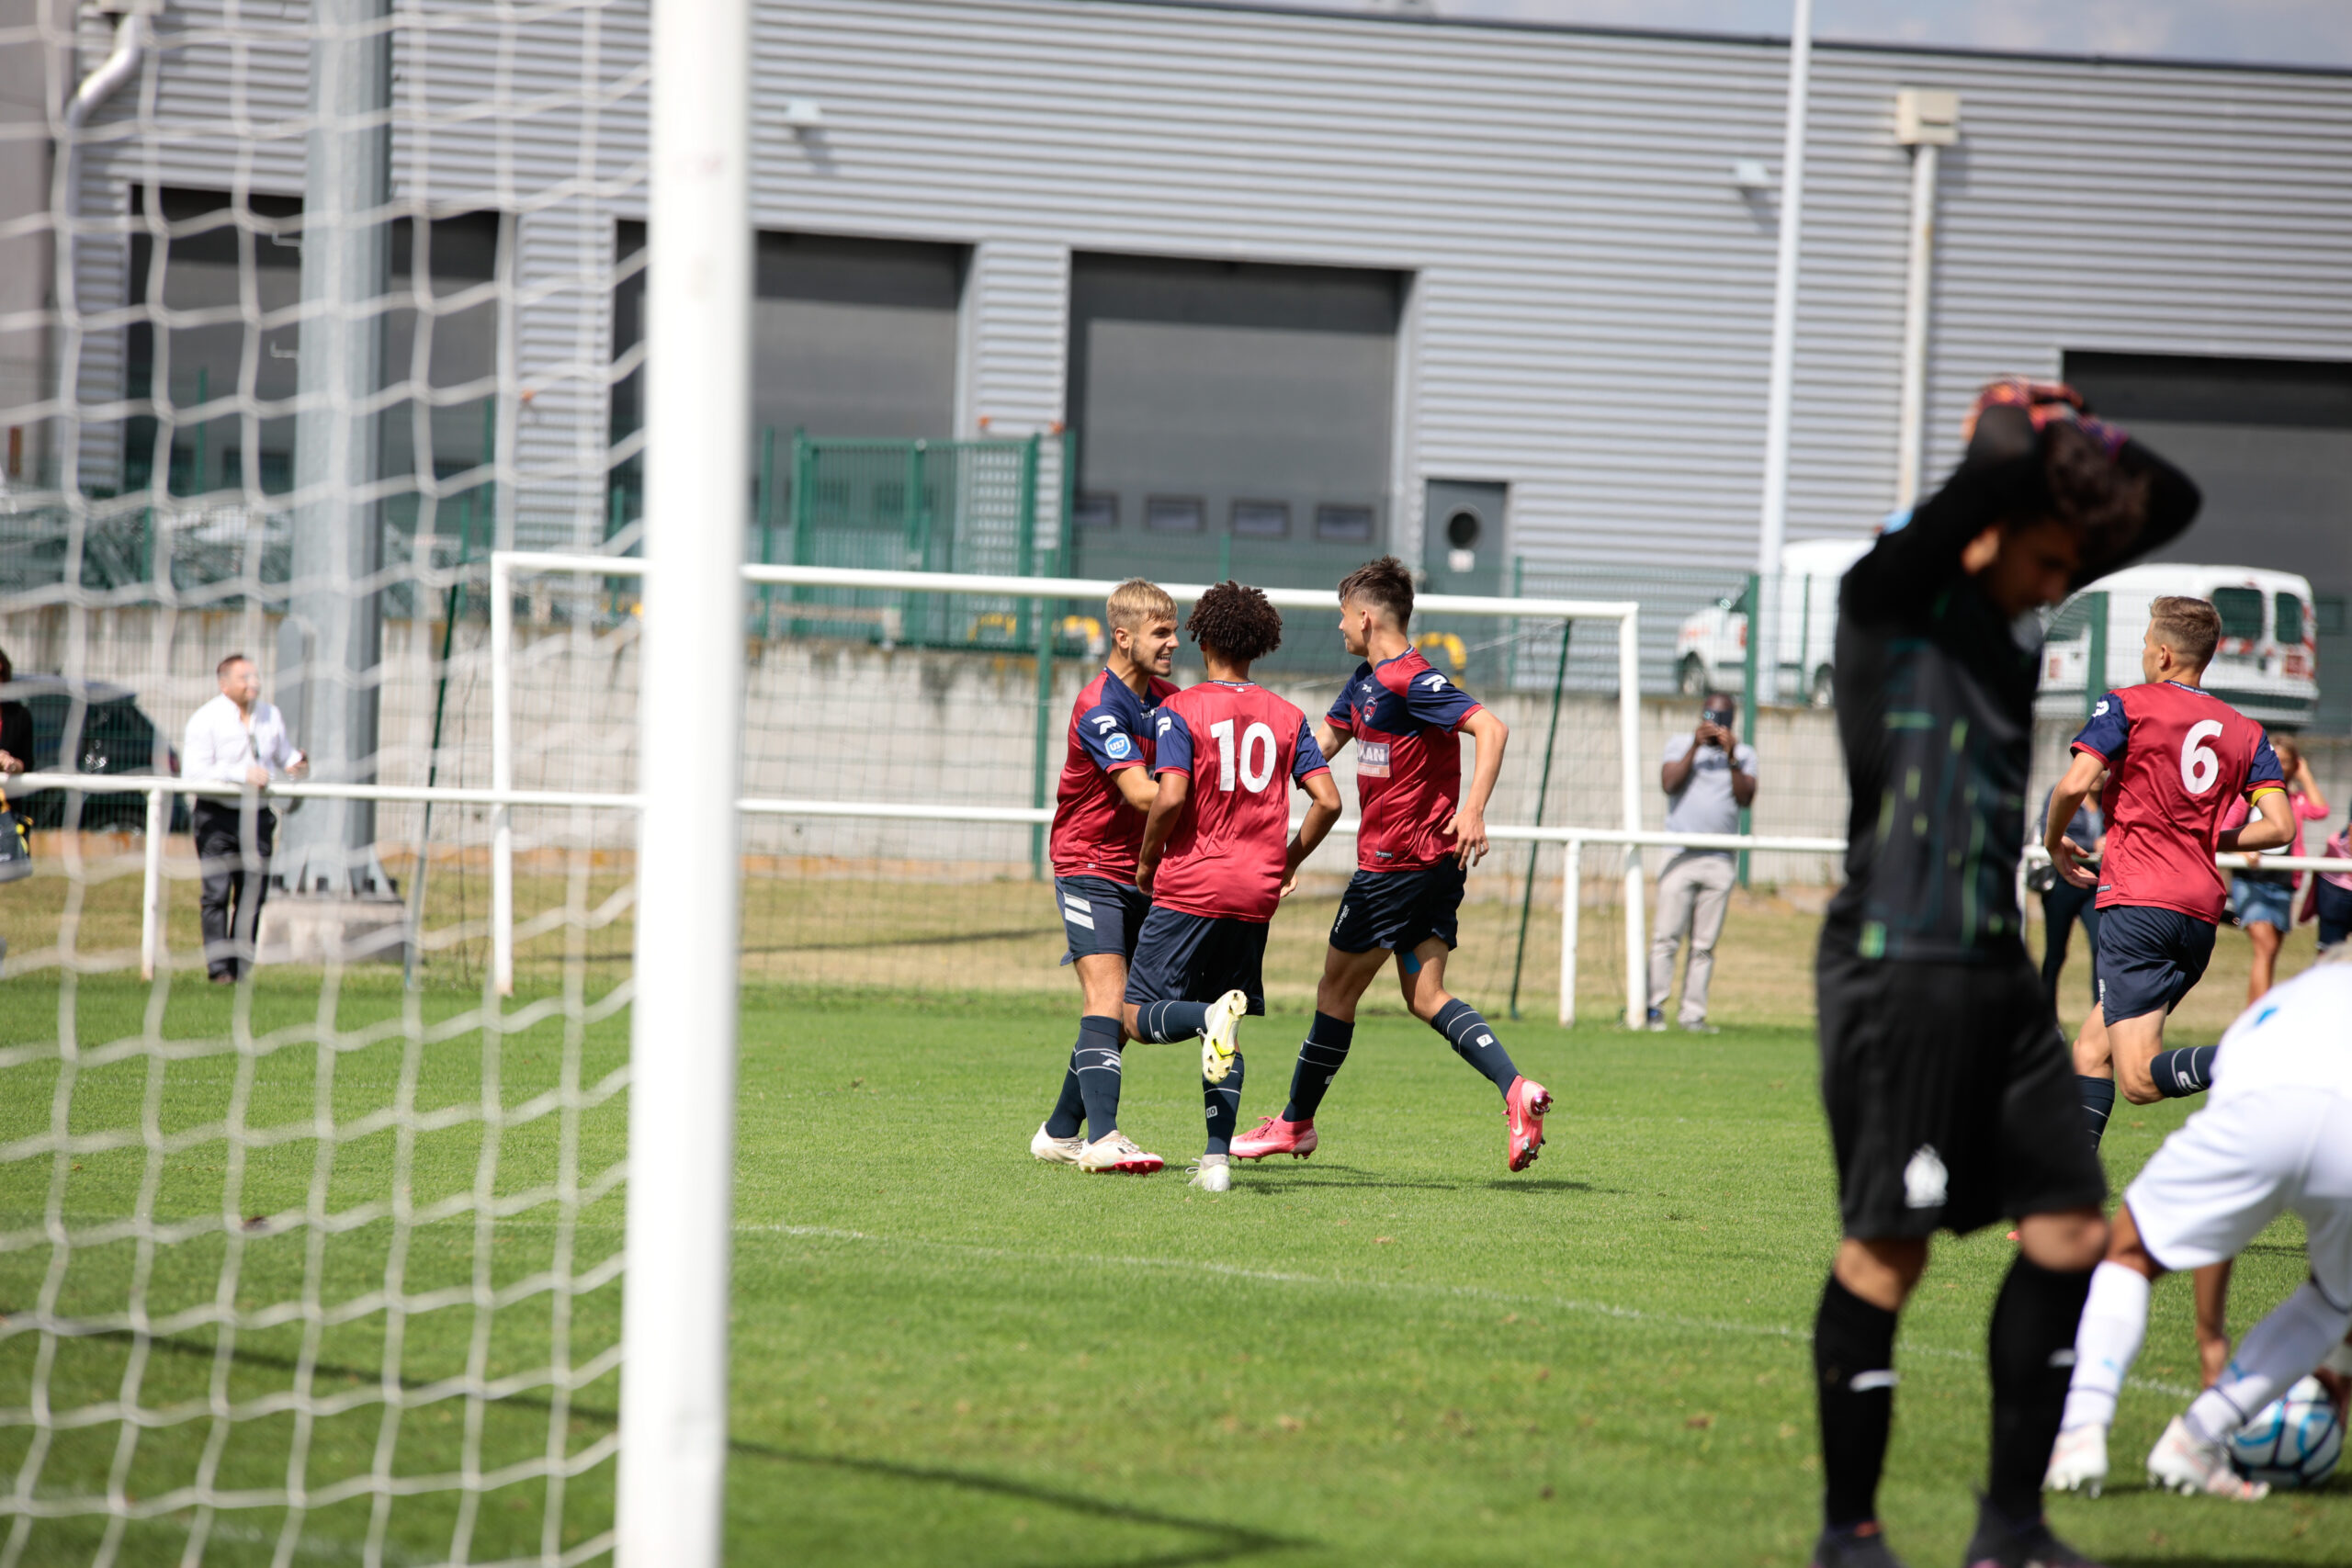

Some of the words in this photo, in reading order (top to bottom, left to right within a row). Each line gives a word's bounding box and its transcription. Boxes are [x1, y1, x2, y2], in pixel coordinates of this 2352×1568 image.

[1109, 739, 1125, 751] U17
[1210, 718, 1277, 794] 10
[2179, 719, 2224, 795] 6
[1206, 1108, 1216, 1117] 10
